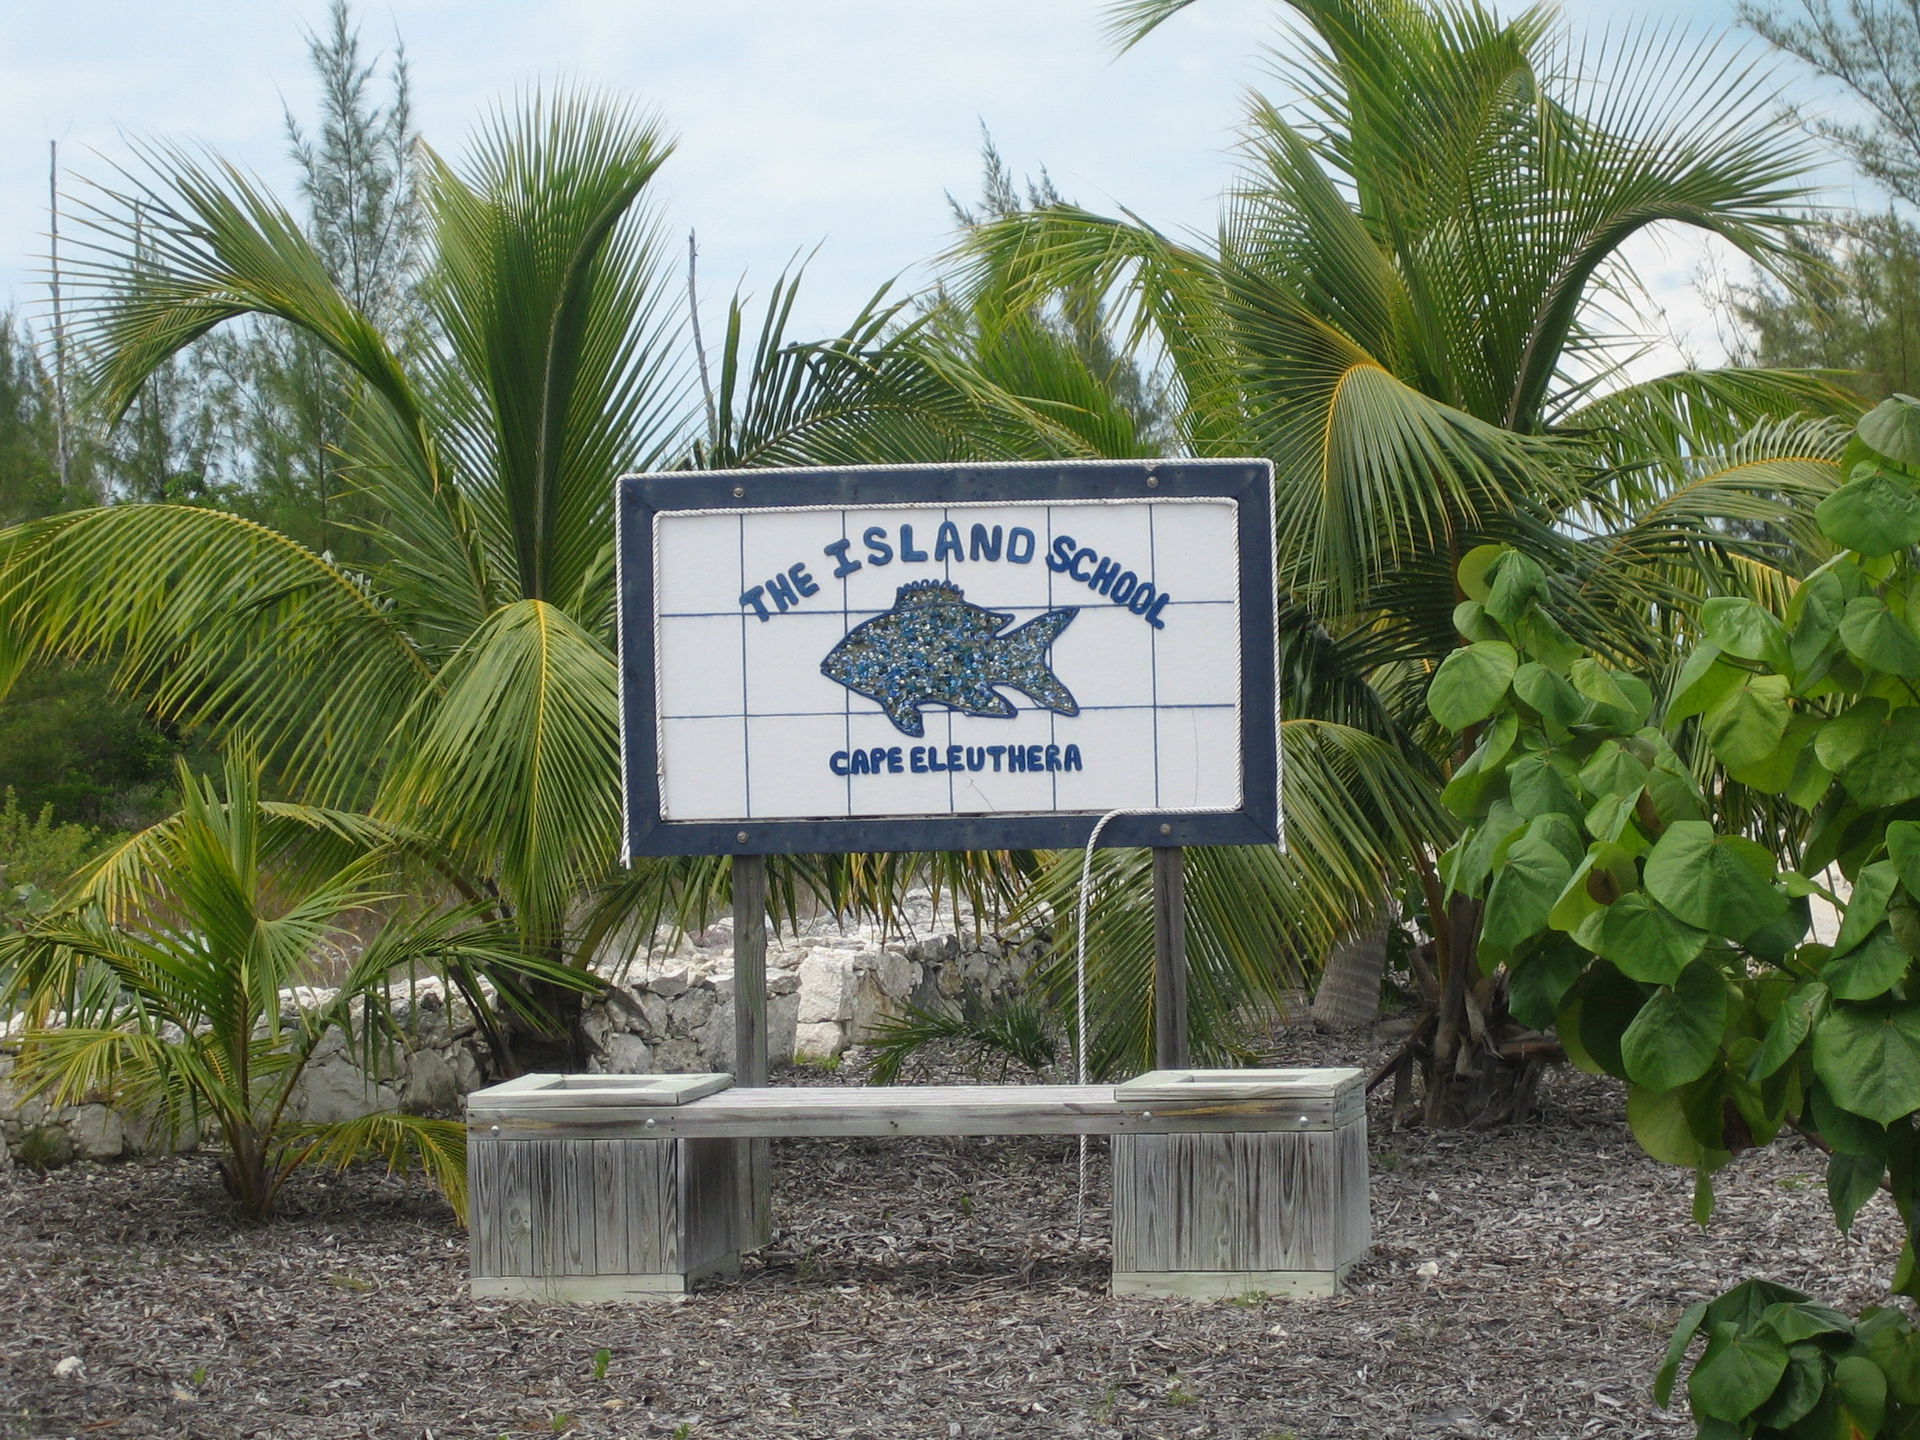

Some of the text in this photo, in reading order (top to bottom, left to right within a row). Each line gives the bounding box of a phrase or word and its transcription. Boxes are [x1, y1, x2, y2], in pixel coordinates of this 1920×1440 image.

[740, 521, 1171, 631] THE ISLAND SCHOOL
[829, 744, 1083, 776] CAPE ELEUTHERA
